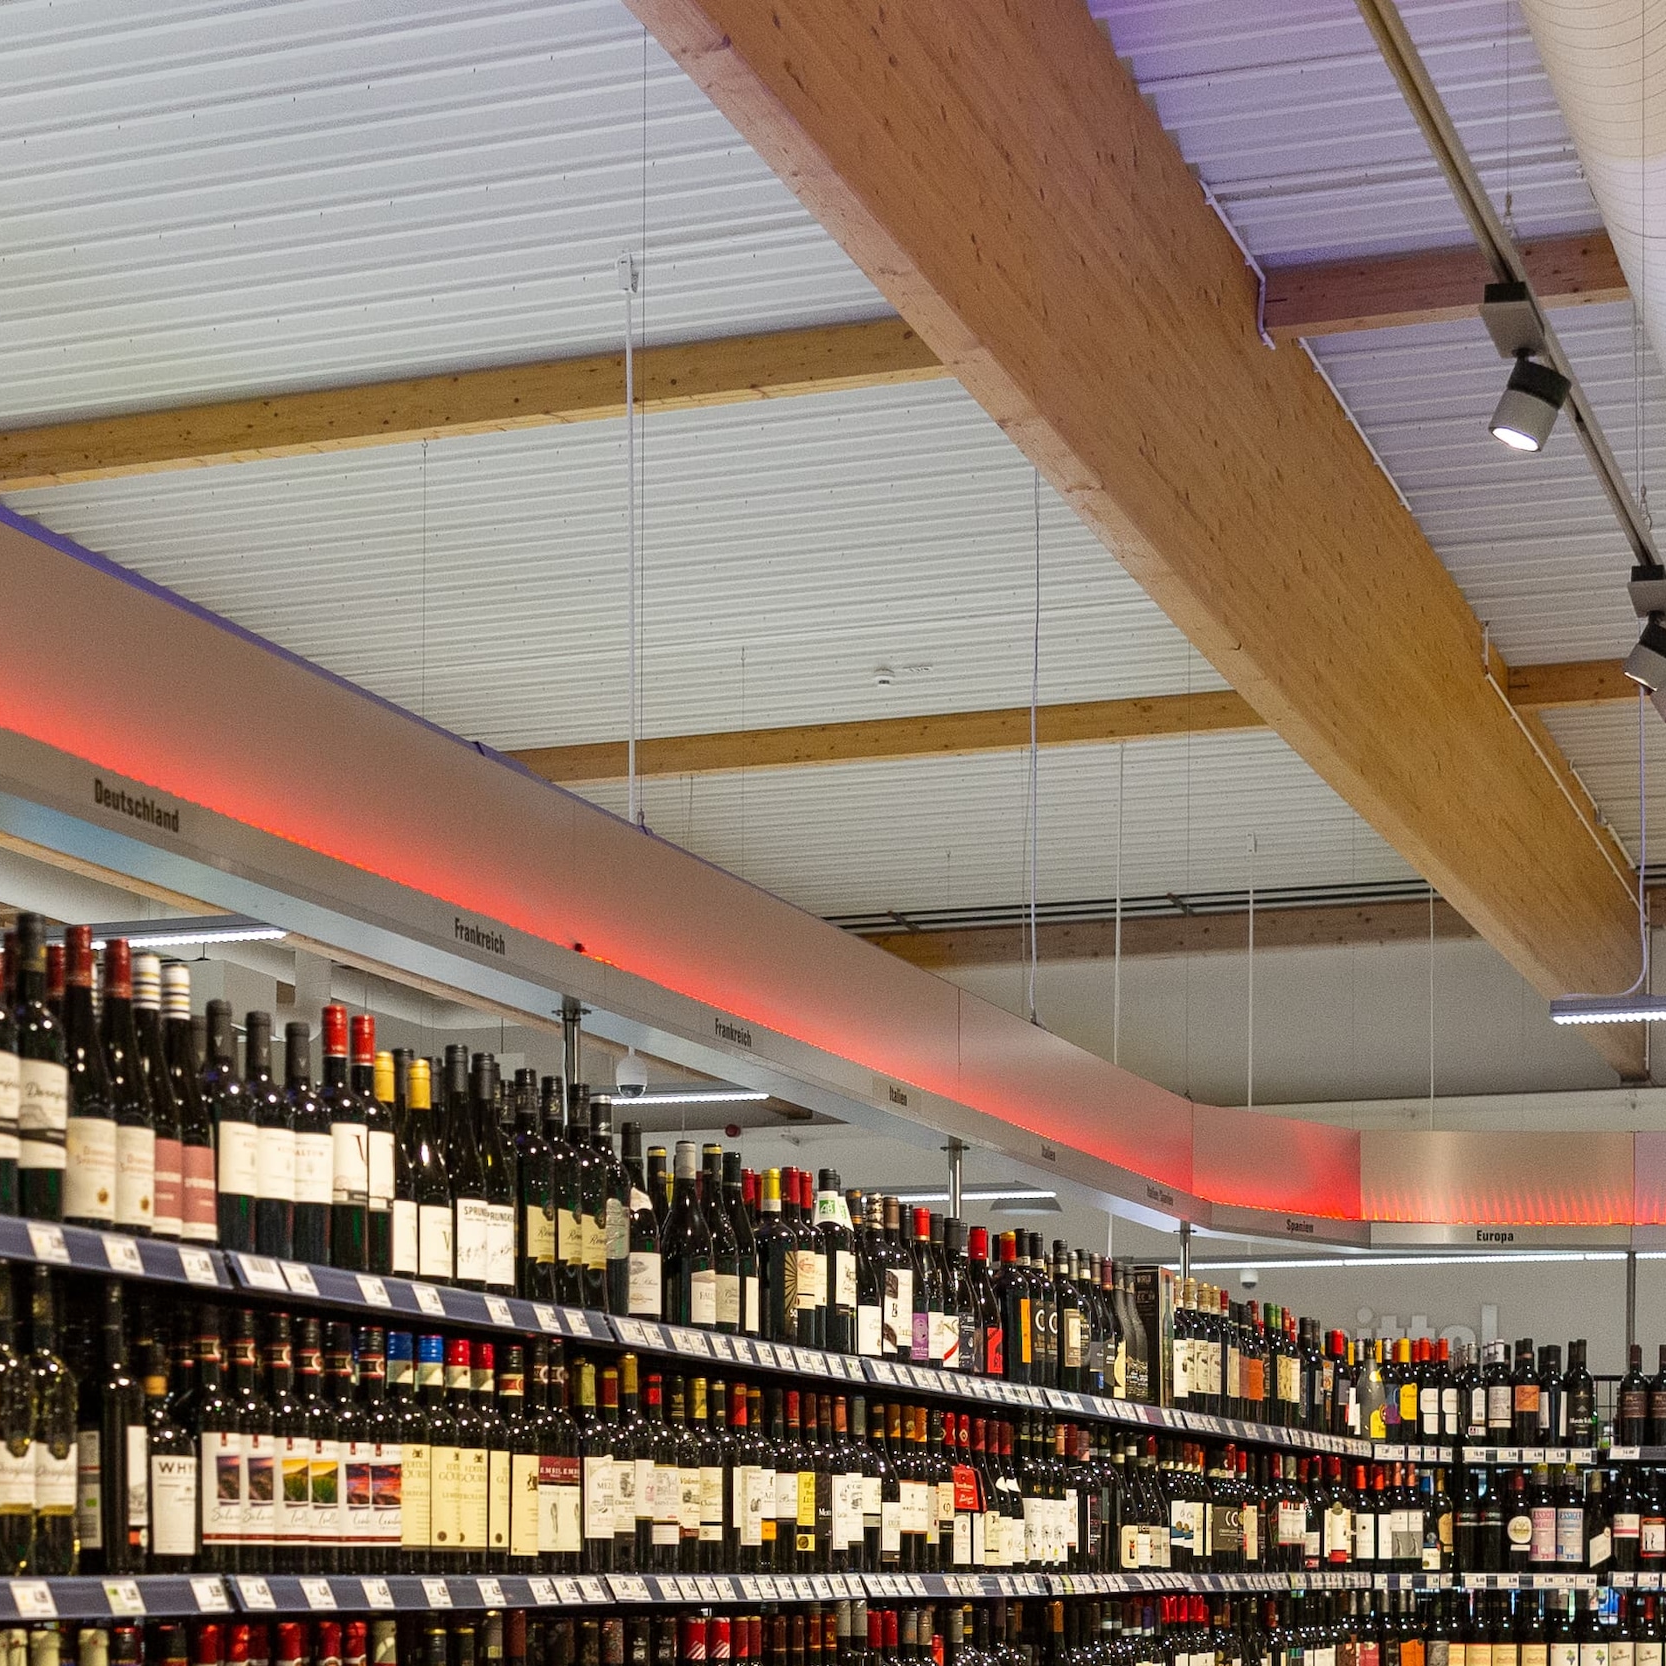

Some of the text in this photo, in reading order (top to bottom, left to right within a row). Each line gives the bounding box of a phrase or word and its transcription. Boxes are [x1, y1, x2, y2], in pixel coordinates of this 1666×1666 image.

[94, 778, 180, 833] Deutschland
[454, 918, 506, 956] Frankreich
[714, 1017, 753, 1048] Frankreich
[889, 1084, 908, 1107] Italien
[1286, 1218, 1315, 1234] Spanien
[1475, 1229, 1514, 1244] Europa
